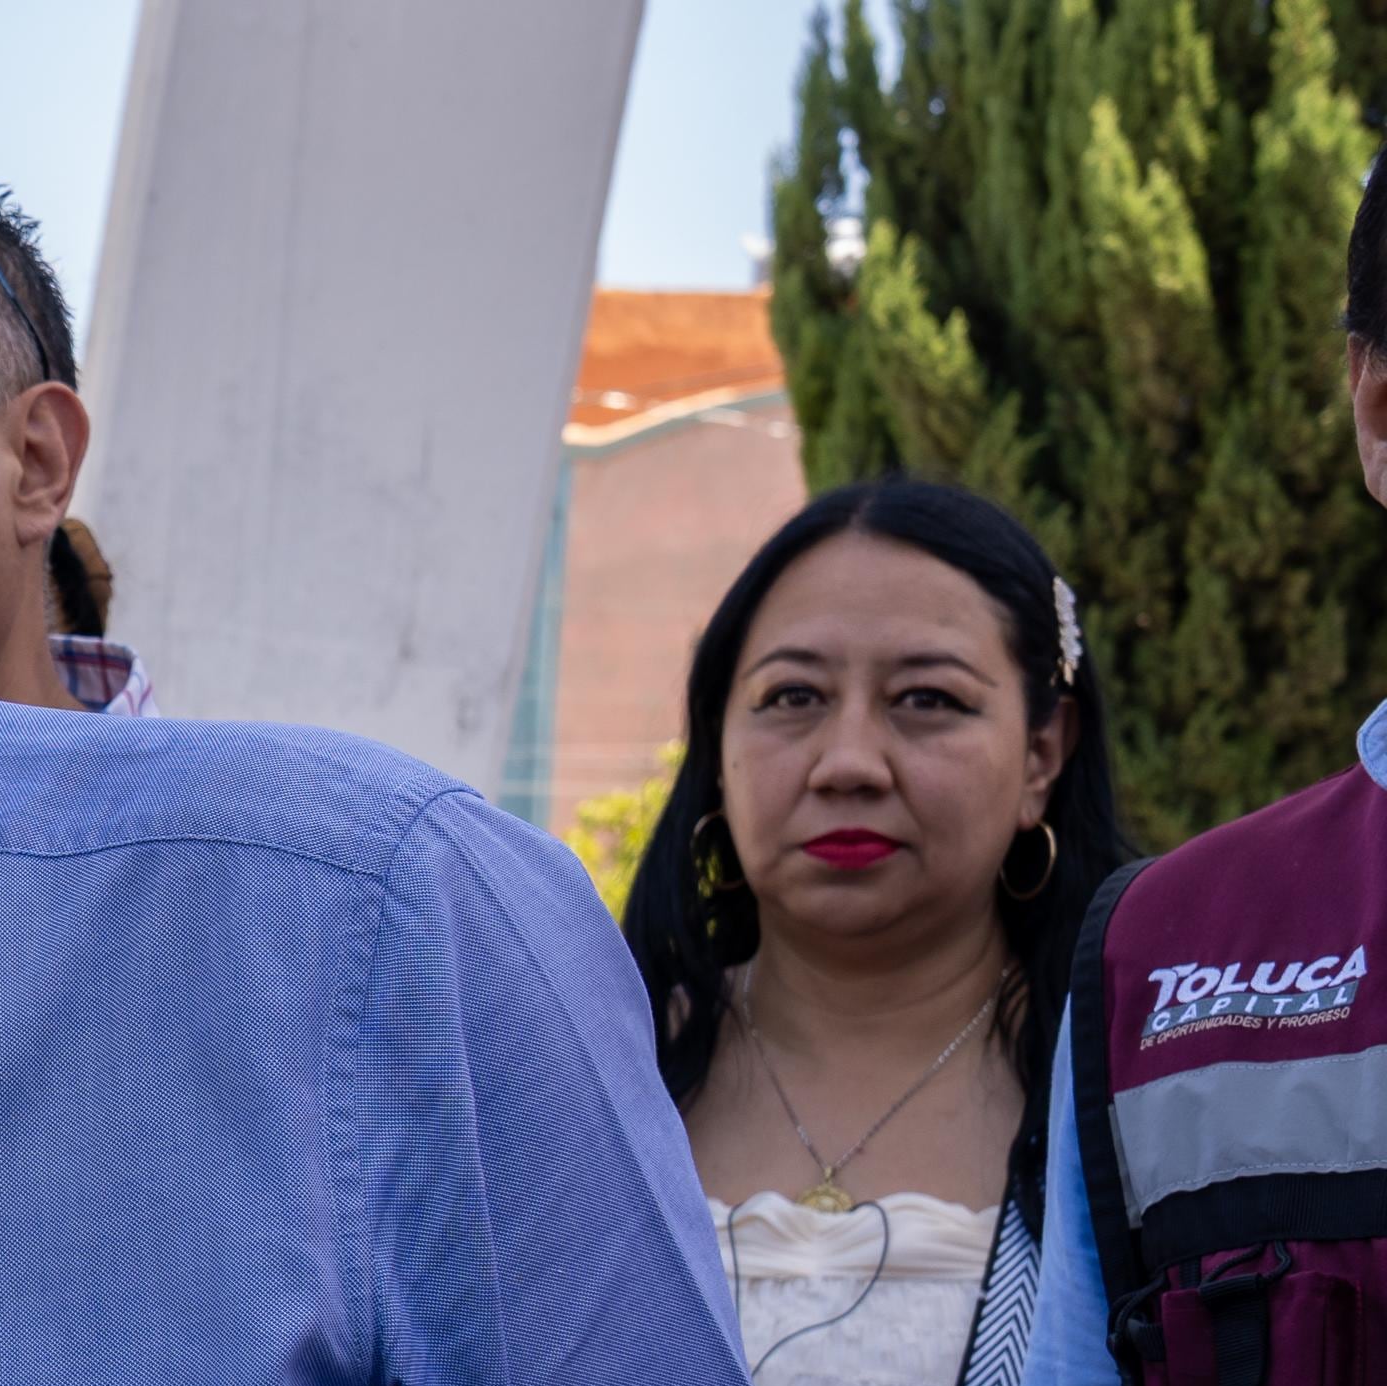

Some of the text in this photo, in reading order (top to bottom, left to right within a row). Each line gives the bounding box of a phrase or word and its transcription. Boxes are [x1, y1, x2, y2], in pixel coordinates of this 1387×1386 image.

[1148, 944, 1368, 1012] TOLUCA
[1140, 1006, 1351, 1050] DE OPORTUNIDADES Y PROGRESO
[1151, 986, 1348, 1032] CAPITAL
